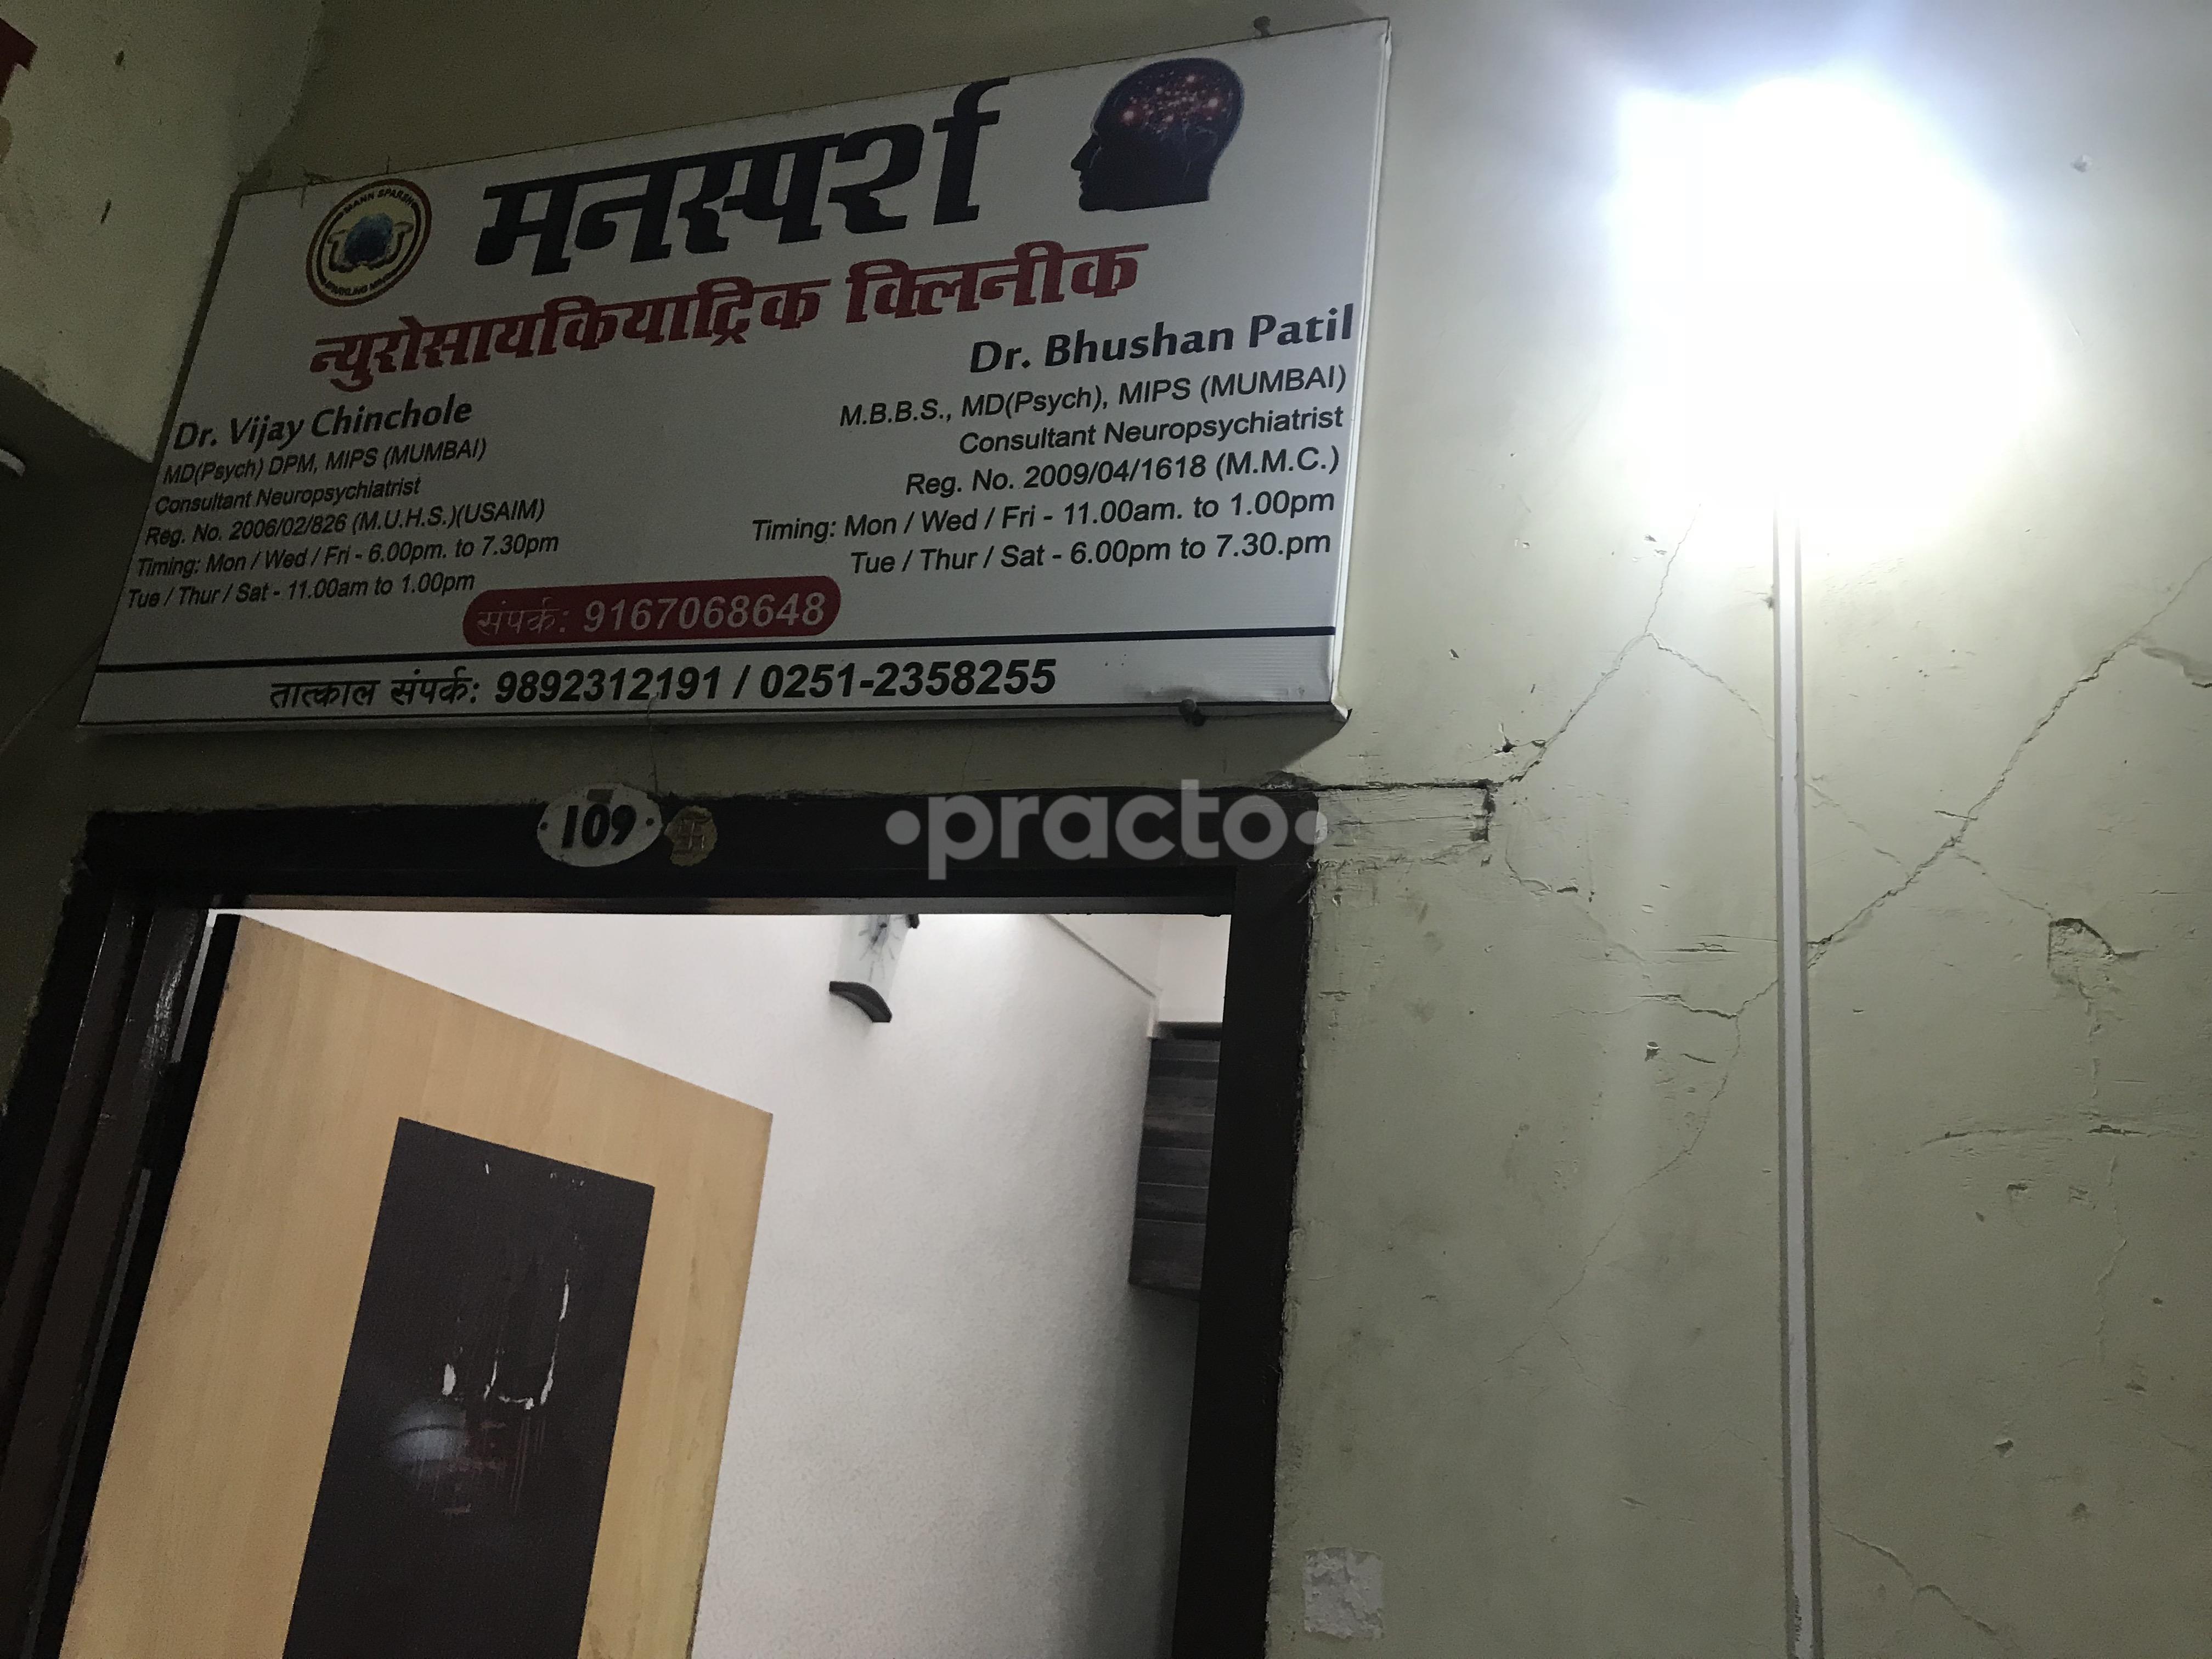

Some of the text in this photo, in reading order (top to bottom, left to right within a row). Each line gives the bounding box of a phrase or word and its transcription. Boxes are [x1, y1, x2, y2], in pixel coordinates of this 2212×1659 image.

[474, 78, 1011, 277] मनस्पर्श
[309, 276, 831, 392] न्युरोसायकियाट्रिक
[970, 304, 1353, 373] Dr. Bhushan Patil
[840, 365, 1345, 426] M.B.B.S., MD(Psych), MIPS (MUMBAI)
[173, 393, 471, 453] Dr. Vijay Chinchole
[959, 407, 1343, 454] Consultant Neuropsychiatrist
[163, 438, 486, 486] MD(Psych) DPM, MIPS (MUMBAI)
[906, 446, 1339, 498] Reg. No. 2009/04/1618 (M.M.C.)
[155, 477, 421, 516] Consultant Neuropsychiatrist
[753, 518, 836, 543] Timing:
[845, 515, 896, 536] Mon
[904, 511, 915, 533] /
[922, 509, 978, 532] Wed
[984, 507, 995, 529] /
[1002, 505, 1035, 528] Fri
[1065, 500, 1182, 525] 11.00am.
[1194, 496, 1218, 518] to
[1232, 490, 1334, 518] 1.00pm
[145, 527, 185, 548] Reg.
[193, 523, 221, 542] No.
[229, 513, 347, 540] 2006/02/826
[851, 552, 895, 573] Tue
[902, 550, 913, 572] /
[921, 549, 978, 571] Thur
[983, 546, 994, 568] /
[1001, 545, 1045, 567] Sat
[1071, 540, 1170, 567] 6.00pm
[1181, 538, 1205, 559] to
[1217, 532, 1330, 560] 7.30.pm
[138, 557, 200, 579] Timing:
[206, 554, 246, 573] Mon
[250, 551, 261, 570] /
[266, 548, 308, 569] Wed
[311, 547, 321, 567] /
[324, 546, 351, 566] Fri
[369, 541, 446, 565] 6.00pm.
[455, 539, 474, 557] to
[482, 534, 558, 558] 7.30pm
[129, 589, 160, 608] Tue
[163, 587, 175, 606] /
[179, 586, 221, 605] Thur
[222, 583, 233, 603] /
[236, 583, 269, 602] Sat
[289, 578, 368, 600] 11.00am
[375, 577, 393, 595] to
[403, 572, 475, 596] 1.00pm
[584, 592, 826, 632] 9167068648
[270, 680, 381, 708] तात्काल
[495, 666, 720, 703] 9892312191
[733, 665, 751, 699] /
[760, 659, 1056, 698] 0251-2358255
[561, 804, 636, 849] 109
